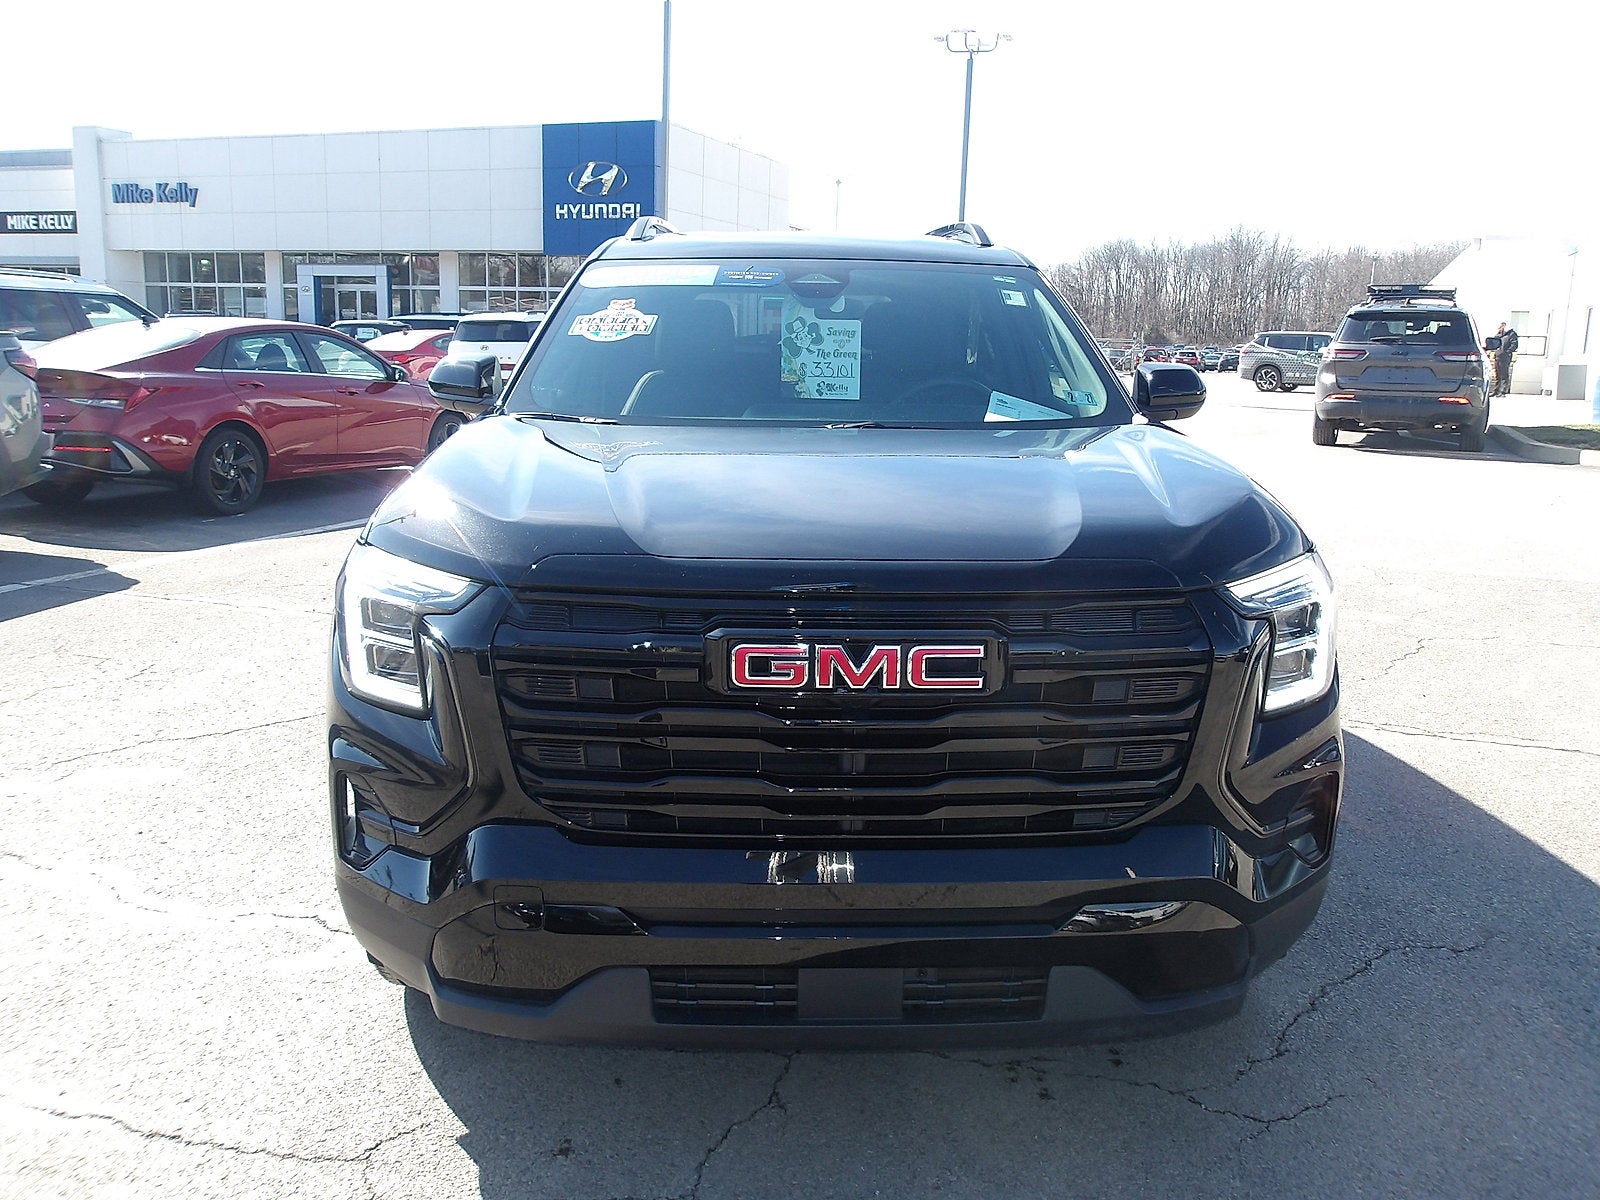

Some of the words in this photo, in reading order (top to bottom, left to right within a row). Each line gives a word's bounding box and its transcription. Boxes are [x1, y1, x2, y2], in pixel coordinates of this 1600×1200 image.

[111, 183, 154, 203] Mike
[155, 182, 199, 207] Kelly
[555, 203, 641, 220] HYUNDAI
[6, 214, 38, 230] MIKE
[39, 214, 75, 230] KELLY
[826, 326, 857, 339] Saving
[816, 348, 831, 360] The
[832, 348, 859, 360] Green
[731, 643, 985, 689] GMC
